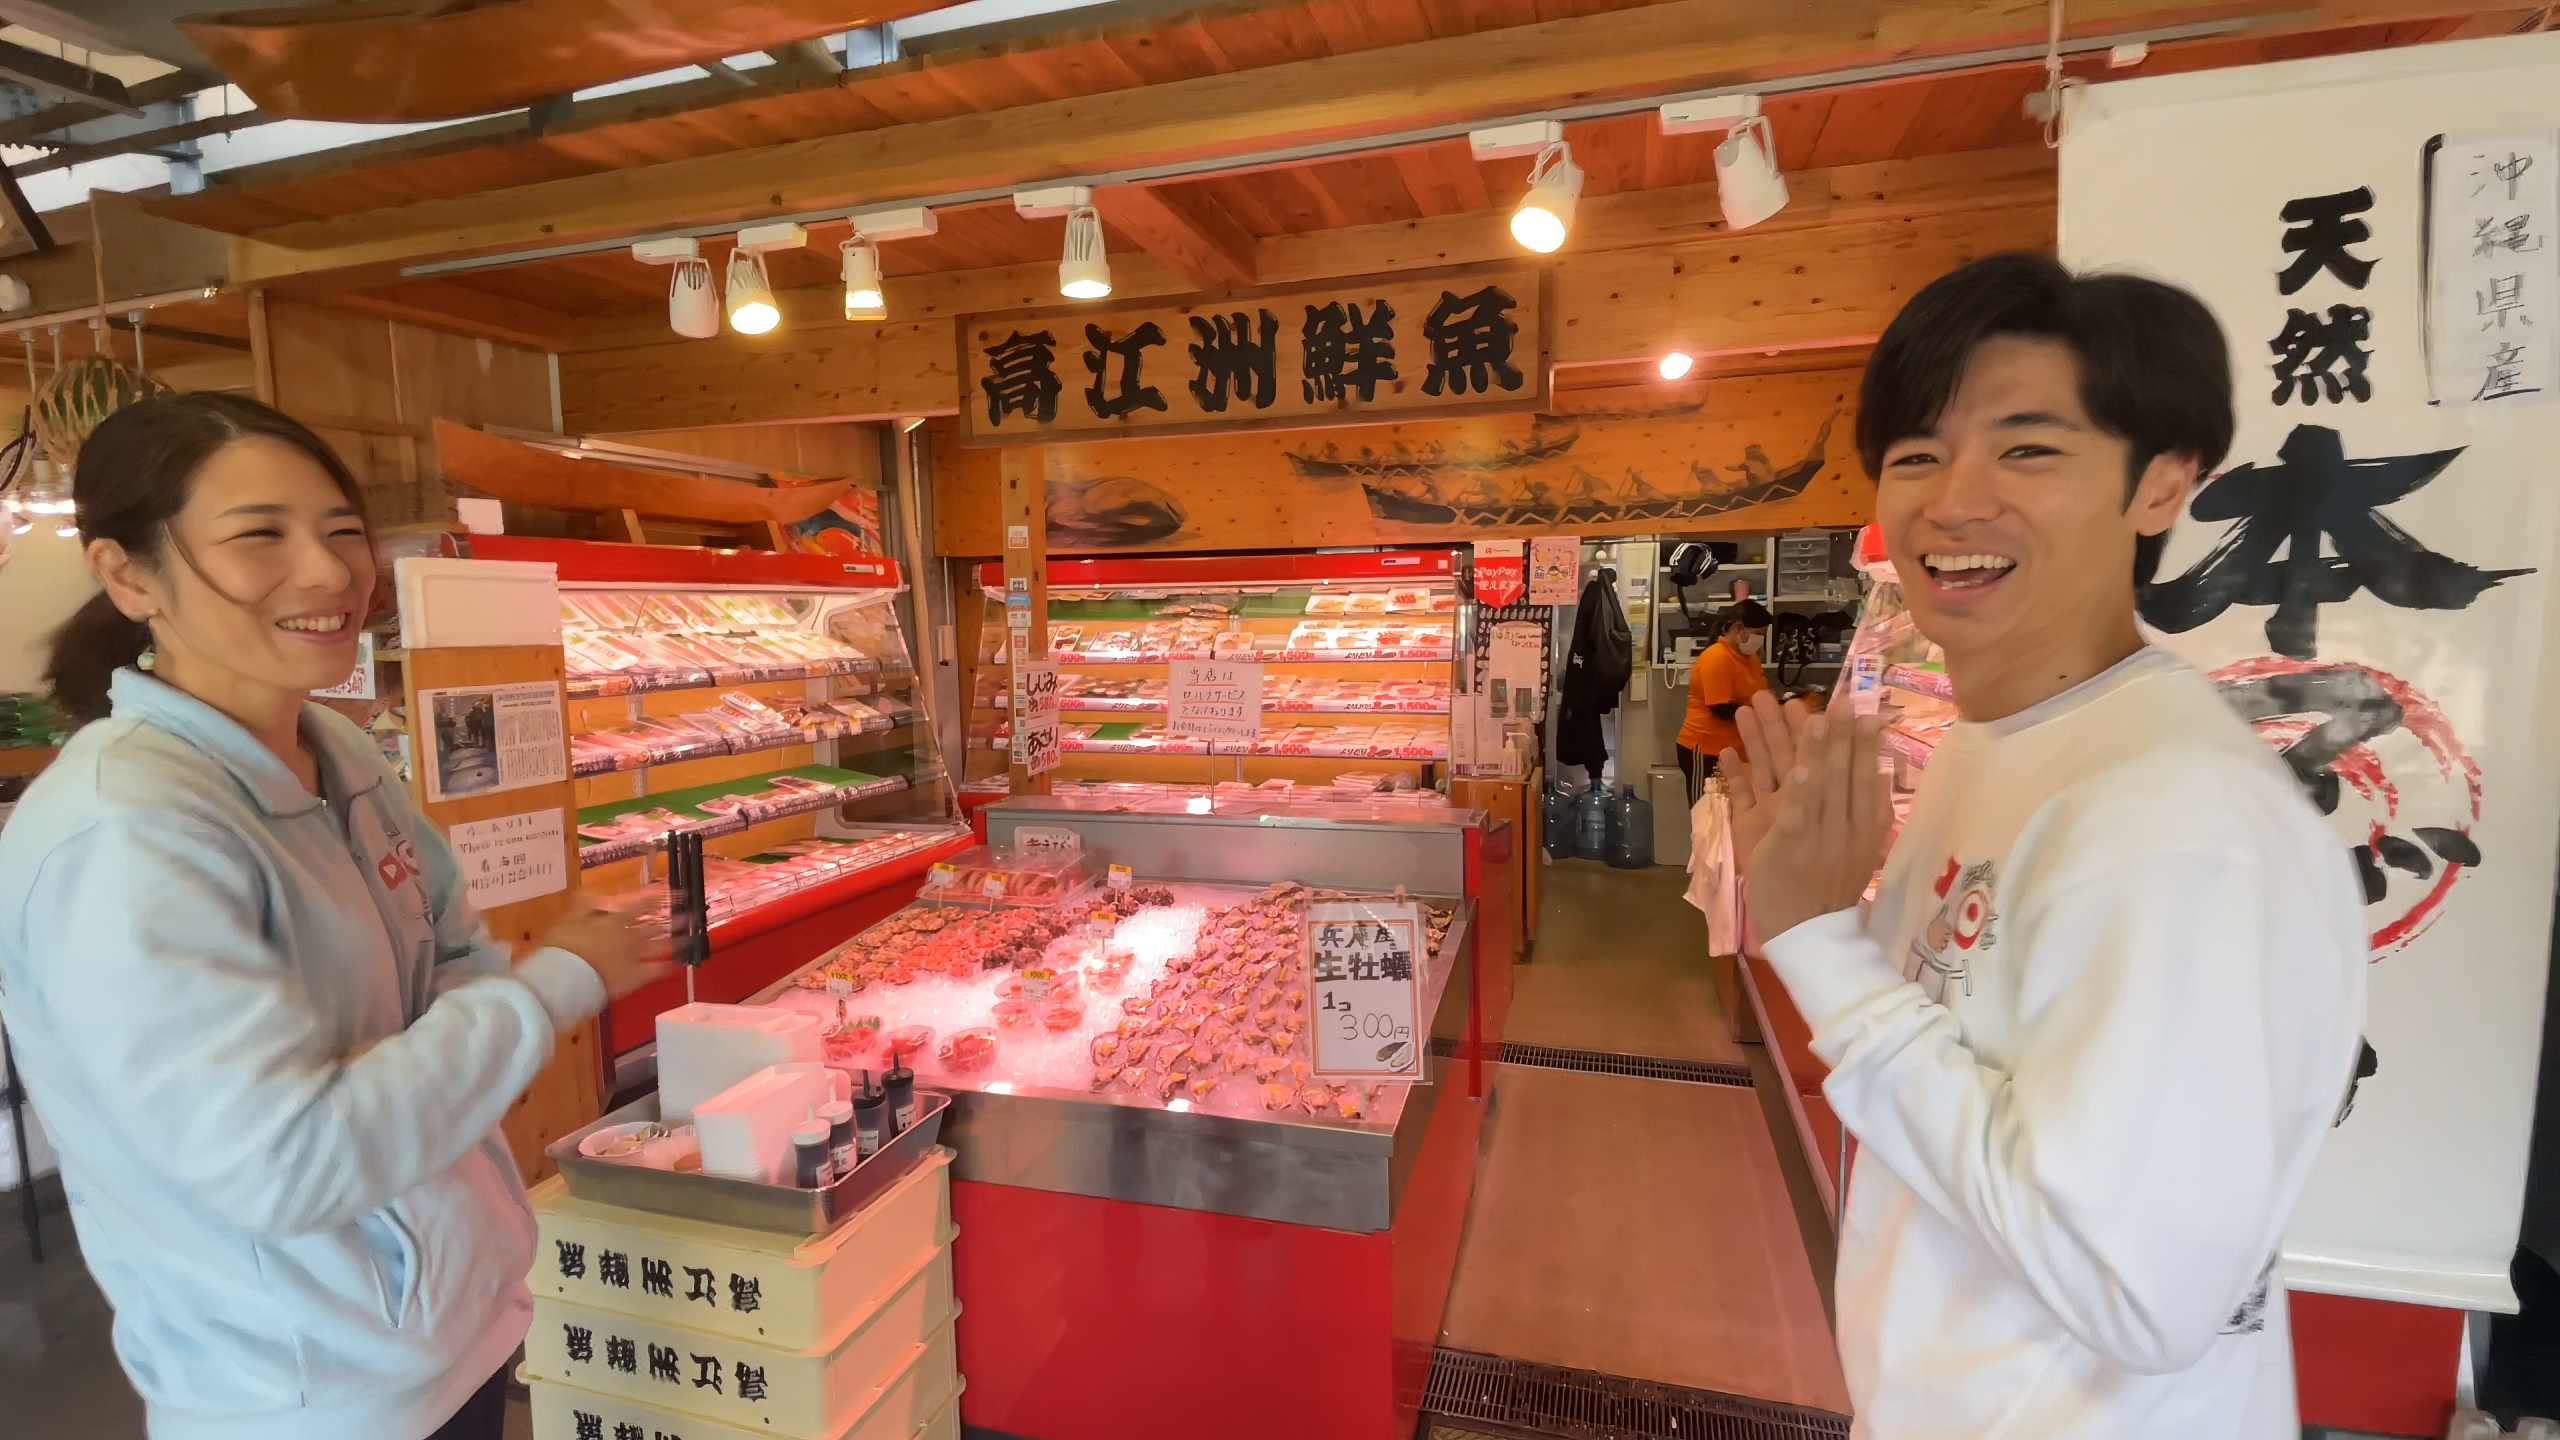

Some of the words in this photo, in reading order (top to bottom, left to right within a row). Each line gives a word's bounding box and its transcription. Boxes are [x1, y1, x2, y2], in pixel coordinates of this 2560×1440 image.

[2267, 185, 2383, 406] 天然
[2470, 151, 2546, 402] 沖縄県産
[981, 285, 1523, 427] 高江洲鮮魚
[1480, 566, 1518, 577] PayPay
[1026, 672, 1058, 696] しじみ
[1027, 726, 1059, 756] あさり
[1314, 950, 1412, 983] 生牡蠣
[1340, 1012, 1410, 1041] 300円
[555, 1239, 761, 1313] 高江洲鮮魚
[563, 1323, 769, 1401] 高江洲鮮魚
